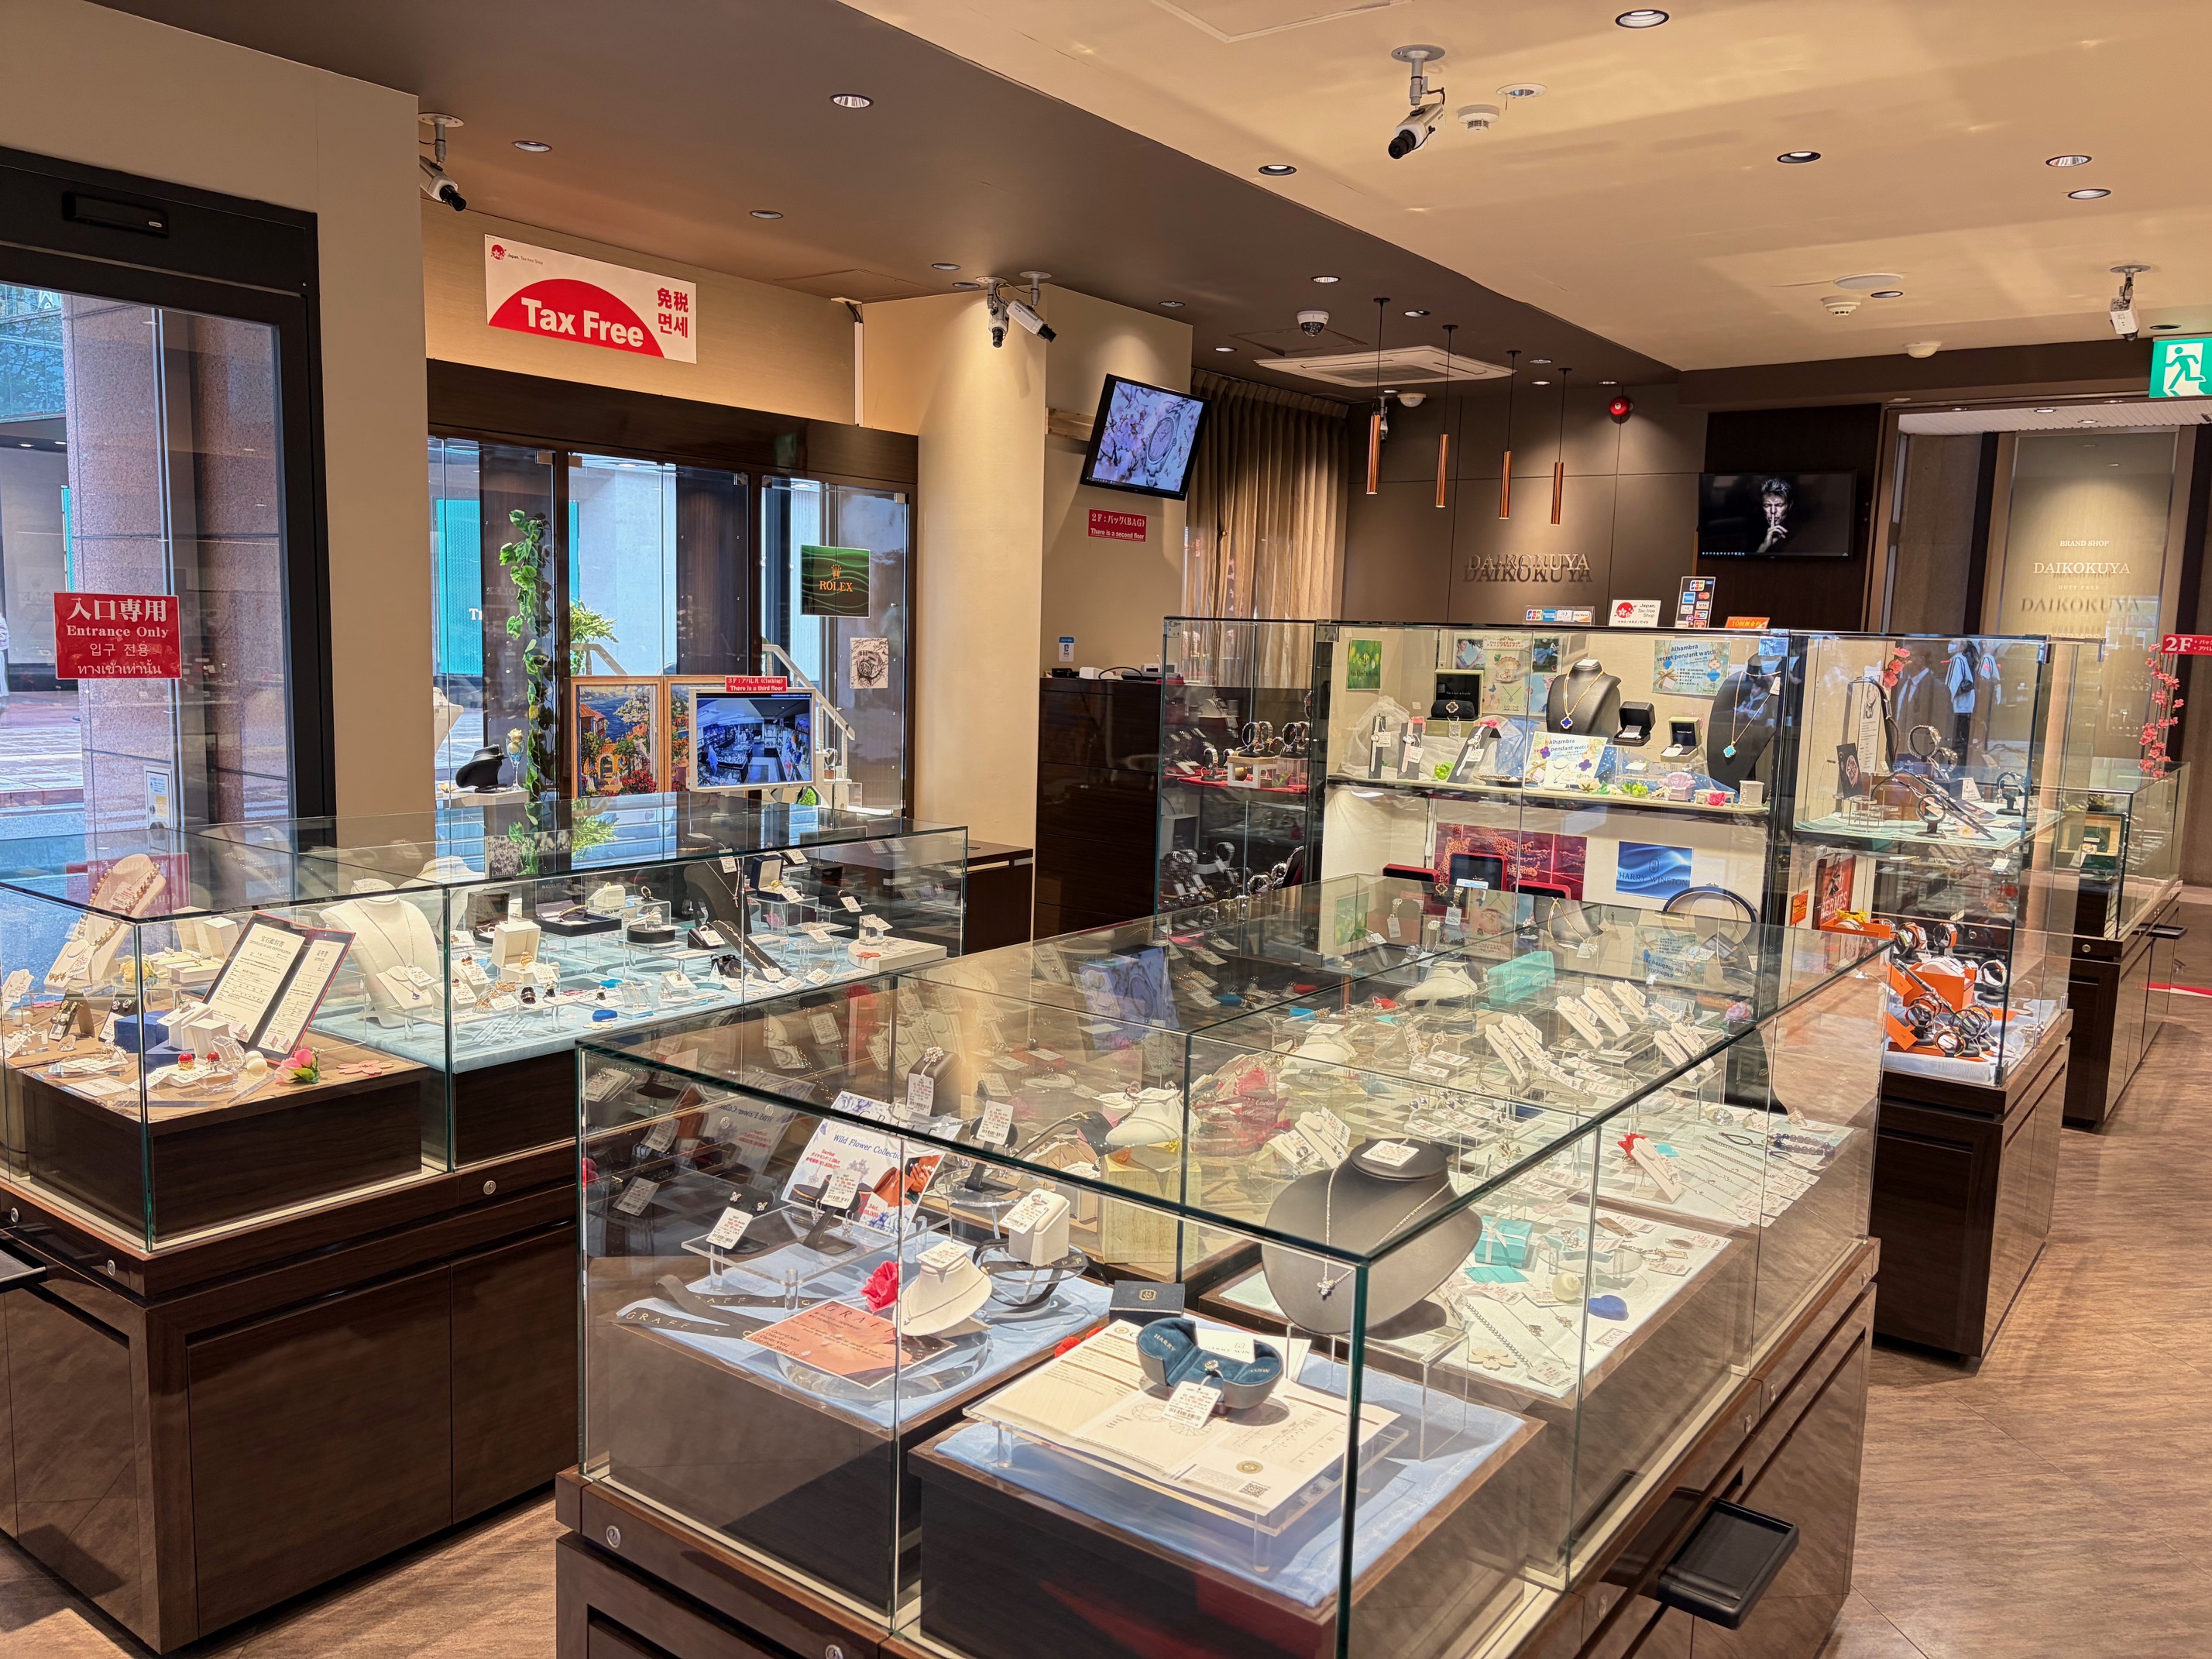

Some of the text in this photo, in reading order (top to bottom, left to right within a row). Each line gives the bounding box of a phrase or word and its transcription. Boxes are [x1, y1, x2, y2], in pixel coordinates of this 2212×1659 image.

[657, 287, 689, 313] 免税
[521, 297, 644, 348] Tax Free
[657, 313, 689, 338] 면세
[1091, 528, 1106, 537] There
[1116, 531, 1133, 539] second
[1468, 553, 1590, 571] DAIKOKUYA
[2033, 562, 2130, 574] DAIKOKUYA
[819, 581, 854, 592] ROLEX
[67, 596, 167, 623] 入口専用
[67, 624, 169, 638] Entrance Only
[89, 643, 150, 657] 입구 전용
[2165, 637, 2193, 652] 2F
[1619, 872, 1688, 886] HARRY WINSTON
[833, 1134, 847, 1145] Wild
[849, 1139, 872, 1151] Flower
[626, 1311, 690, 1328] GRAFF
[1153, 1333, 1176, 1352] HARRY
[1602, 1330, 1623, 1345] GUCCI
